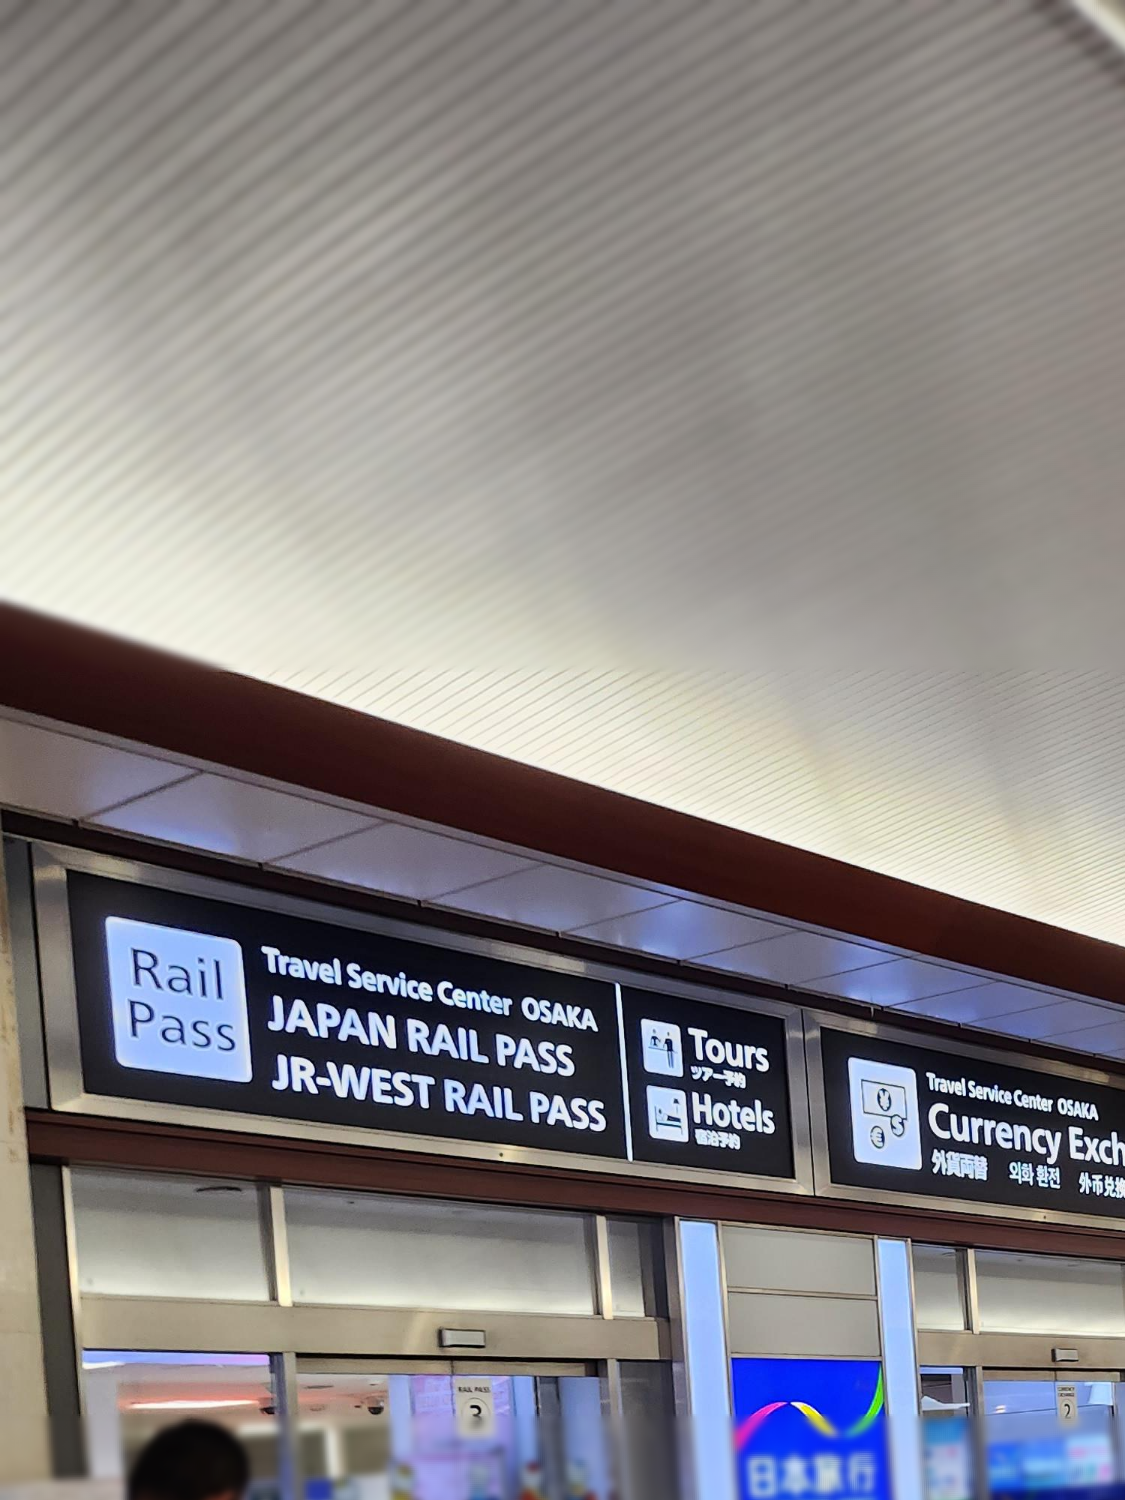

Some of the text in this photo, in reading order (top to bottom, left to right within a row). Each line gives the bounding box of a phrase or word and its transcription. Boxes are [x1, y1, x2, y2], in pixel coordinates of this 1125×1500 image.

[129, 947, 224, 1001] Rail
[261, 946, 599, 1033] Travel Service Center OSAKA
[128, 999, 237, 1053] Pass
[267, 995, 575, 1078] JAPAN RAIL PASS
[687, 1026, 770, 1073] Tours
[271, 1053, 607, 1133] JR-WEST RAIL PASS
[690, 1065, 747, 1090] ツアー予約
[925, 1071, 1099, 1122] Travel Service Center OSAKA
[691, 1091, 776, 1135] Hotels
[927, 1102, 1062, 1165] Currency
[694, 1128, 741, 1150] 宿泊予約
[931, 1149, 988, 1181] 外貨両替
[1009, 1161, 1061, 1190] 외화 환전
[1064, 1403, 1071, 1419] 2
